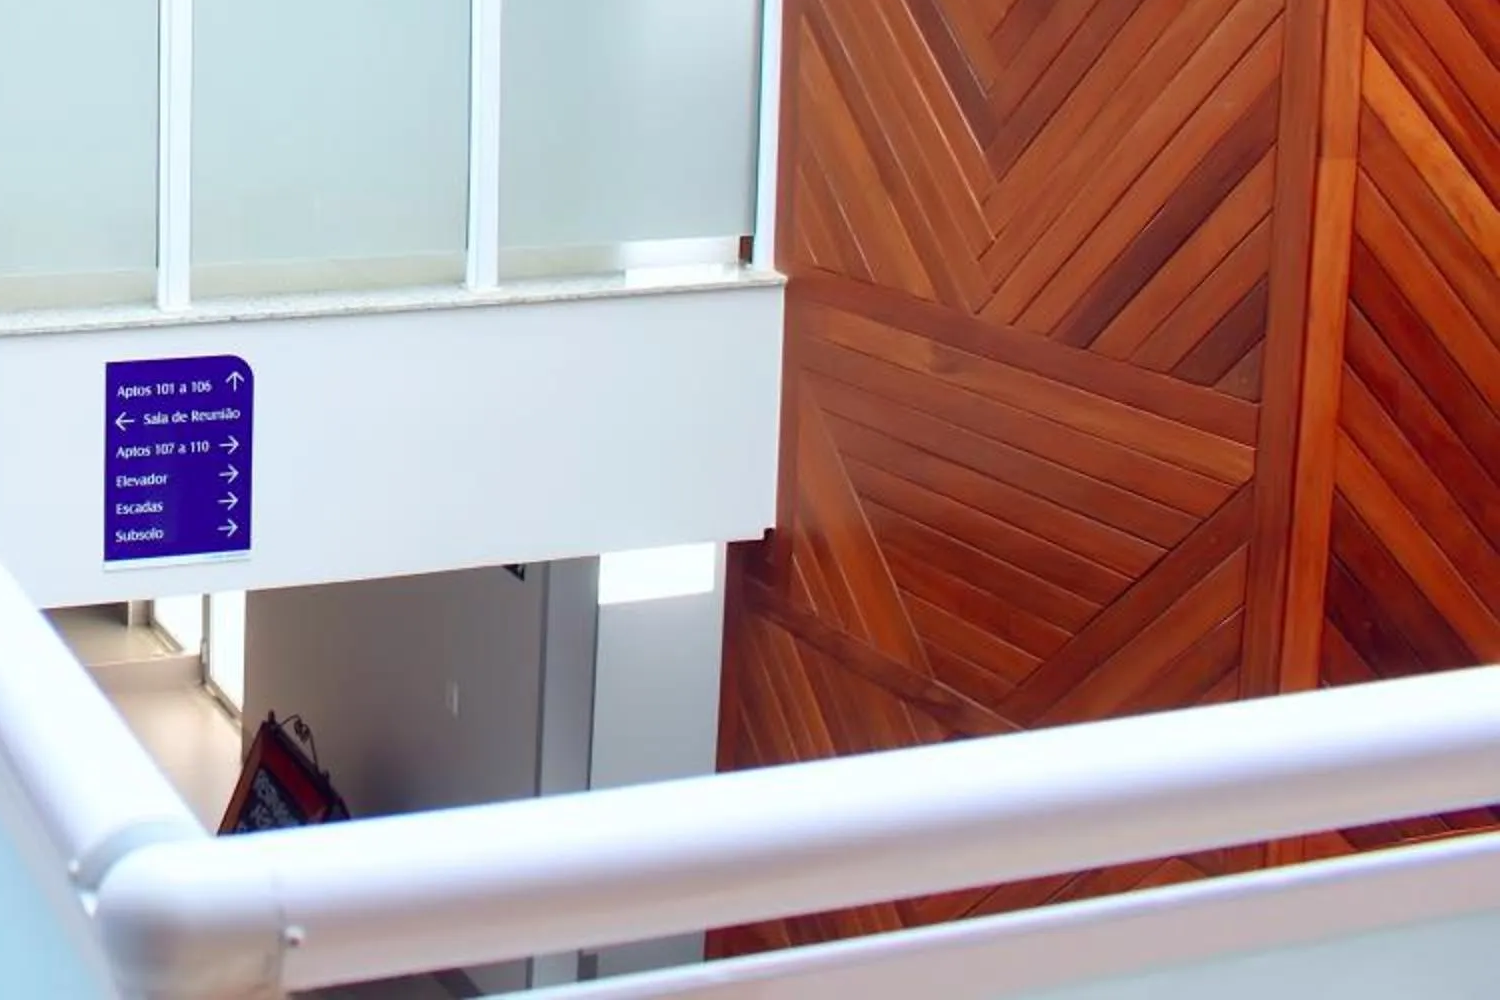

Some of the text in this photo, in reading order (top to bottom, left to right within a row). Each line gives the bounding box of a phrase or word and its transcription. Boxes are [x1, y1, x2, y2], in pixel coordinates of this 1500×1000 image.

[117, 380, 212, 400] Aptos 101 a 106
[143, 407, 241, 426] Sala de Reunião
[116, 440, 210, 460] Aptos 107 a 110
[116, 473, 168, 488] Elevador
[116, 501, 163, 515] Escadas
[115, 528, 164, 543] Subsolo
